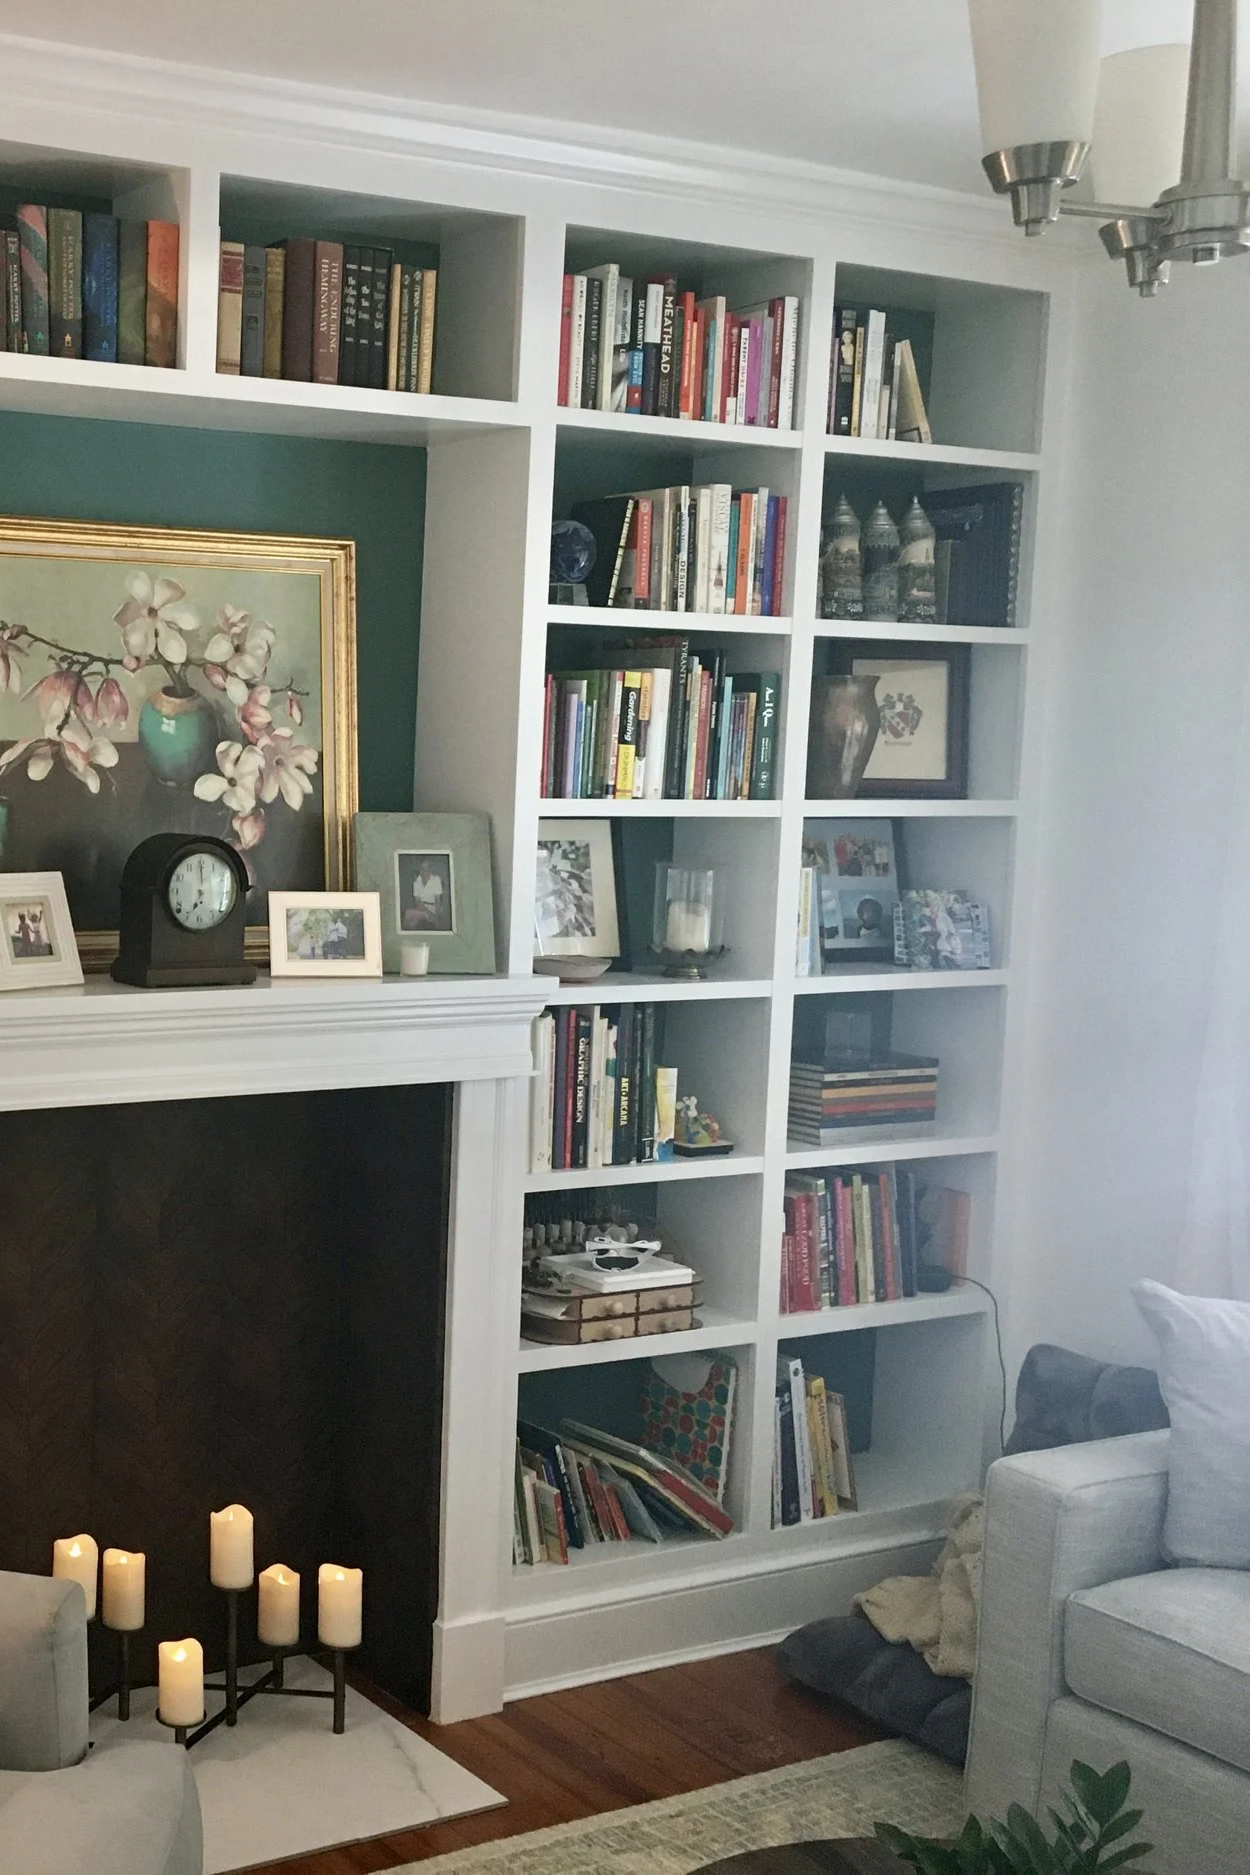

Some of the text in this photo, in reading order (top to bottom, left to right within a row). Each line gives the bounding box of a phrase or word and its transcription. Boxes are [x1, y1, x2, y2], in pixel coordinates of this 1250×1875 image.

[320, 259, 329, 334] HEMINGWAY
[329, 262, 339, 353] THE ENDURING
[636, 319, 644, 350] HANNITY
[661, 296, 675, 374] MEATHEAD
[679, 641, 688, 684] TYRANTS
[624, 691, 637, 741] Gardening
[576, 1037, 586, 1123] GRAPHIC DESIGN
[621, 1077, 630, 1092] ART
[620, 1095, 629, 1126] ARCANA
